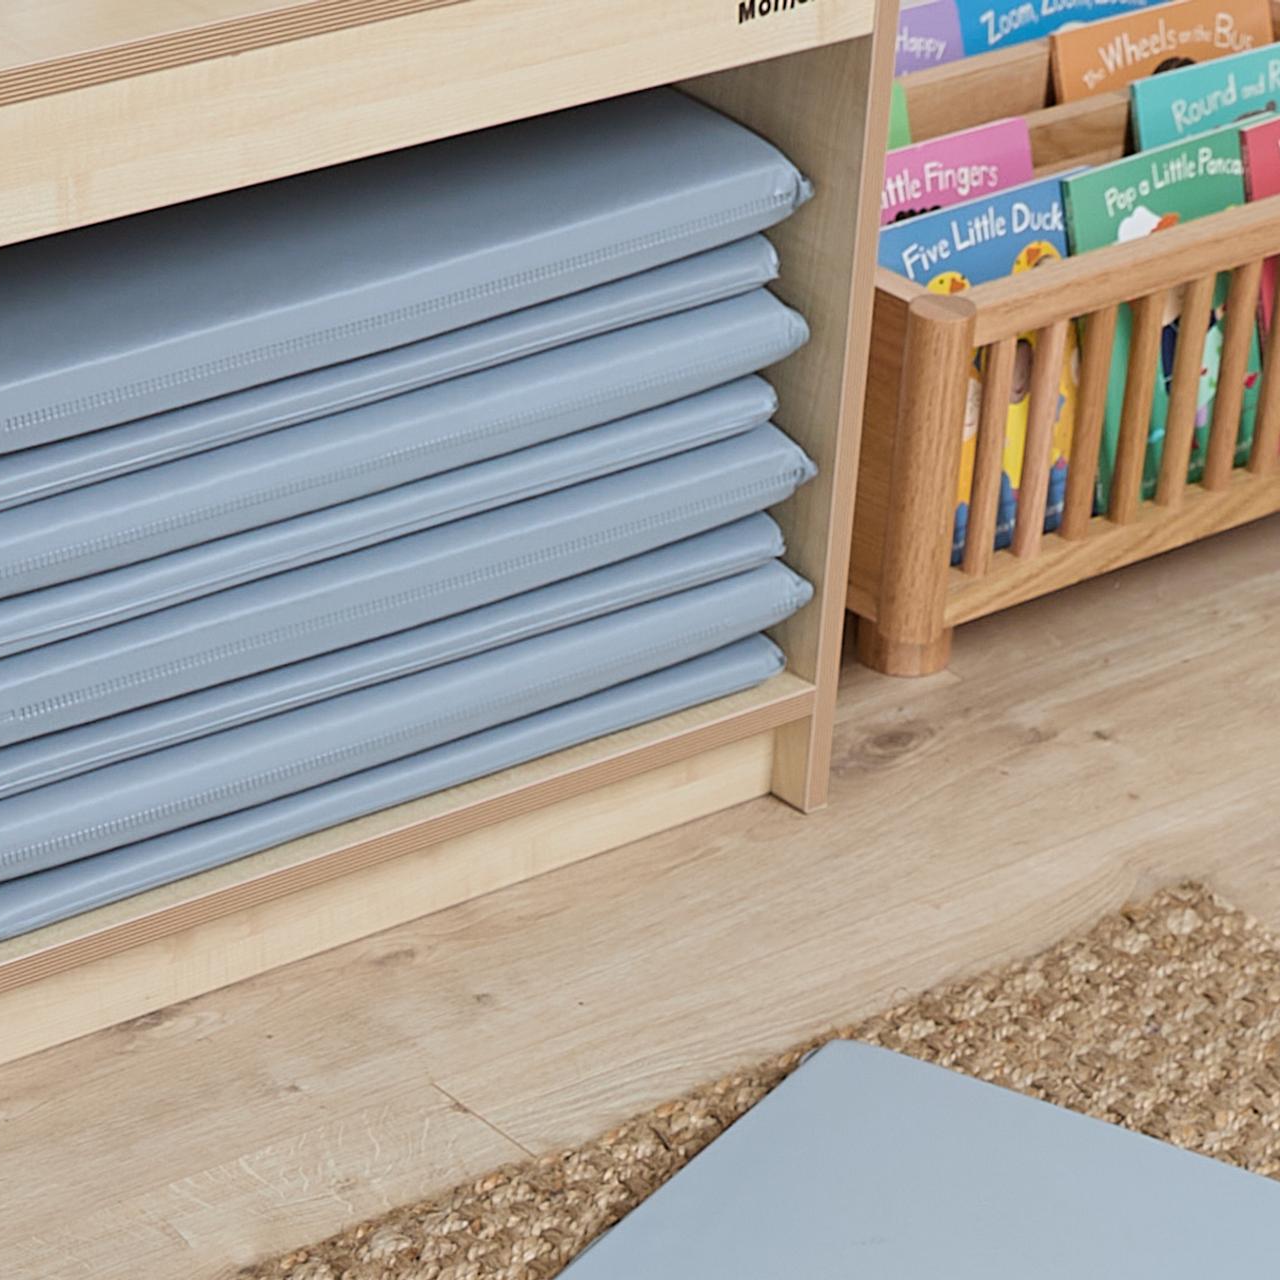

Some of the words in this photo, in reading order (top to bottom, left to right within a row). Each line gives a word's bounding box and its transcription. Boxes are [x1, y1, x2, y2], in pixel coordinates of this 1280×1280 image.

[1099, 18, 1177, 74] Wheels
[1214, 12, 1255, 51] Bus
[1171, 73, 1237, 133] Round
[1241, 74, 1265, 100] and
[880, 168, 922, 209] ittle
[923, 161, 999, 197] Fingers
[1104, 187, 1137, 218] Pop
[1138, 179, 1150, 196] a
[1151, 152, 1197, 190] Little
[901, 238, 951, 280] Five
[951, 206, 1006, 251] Little
